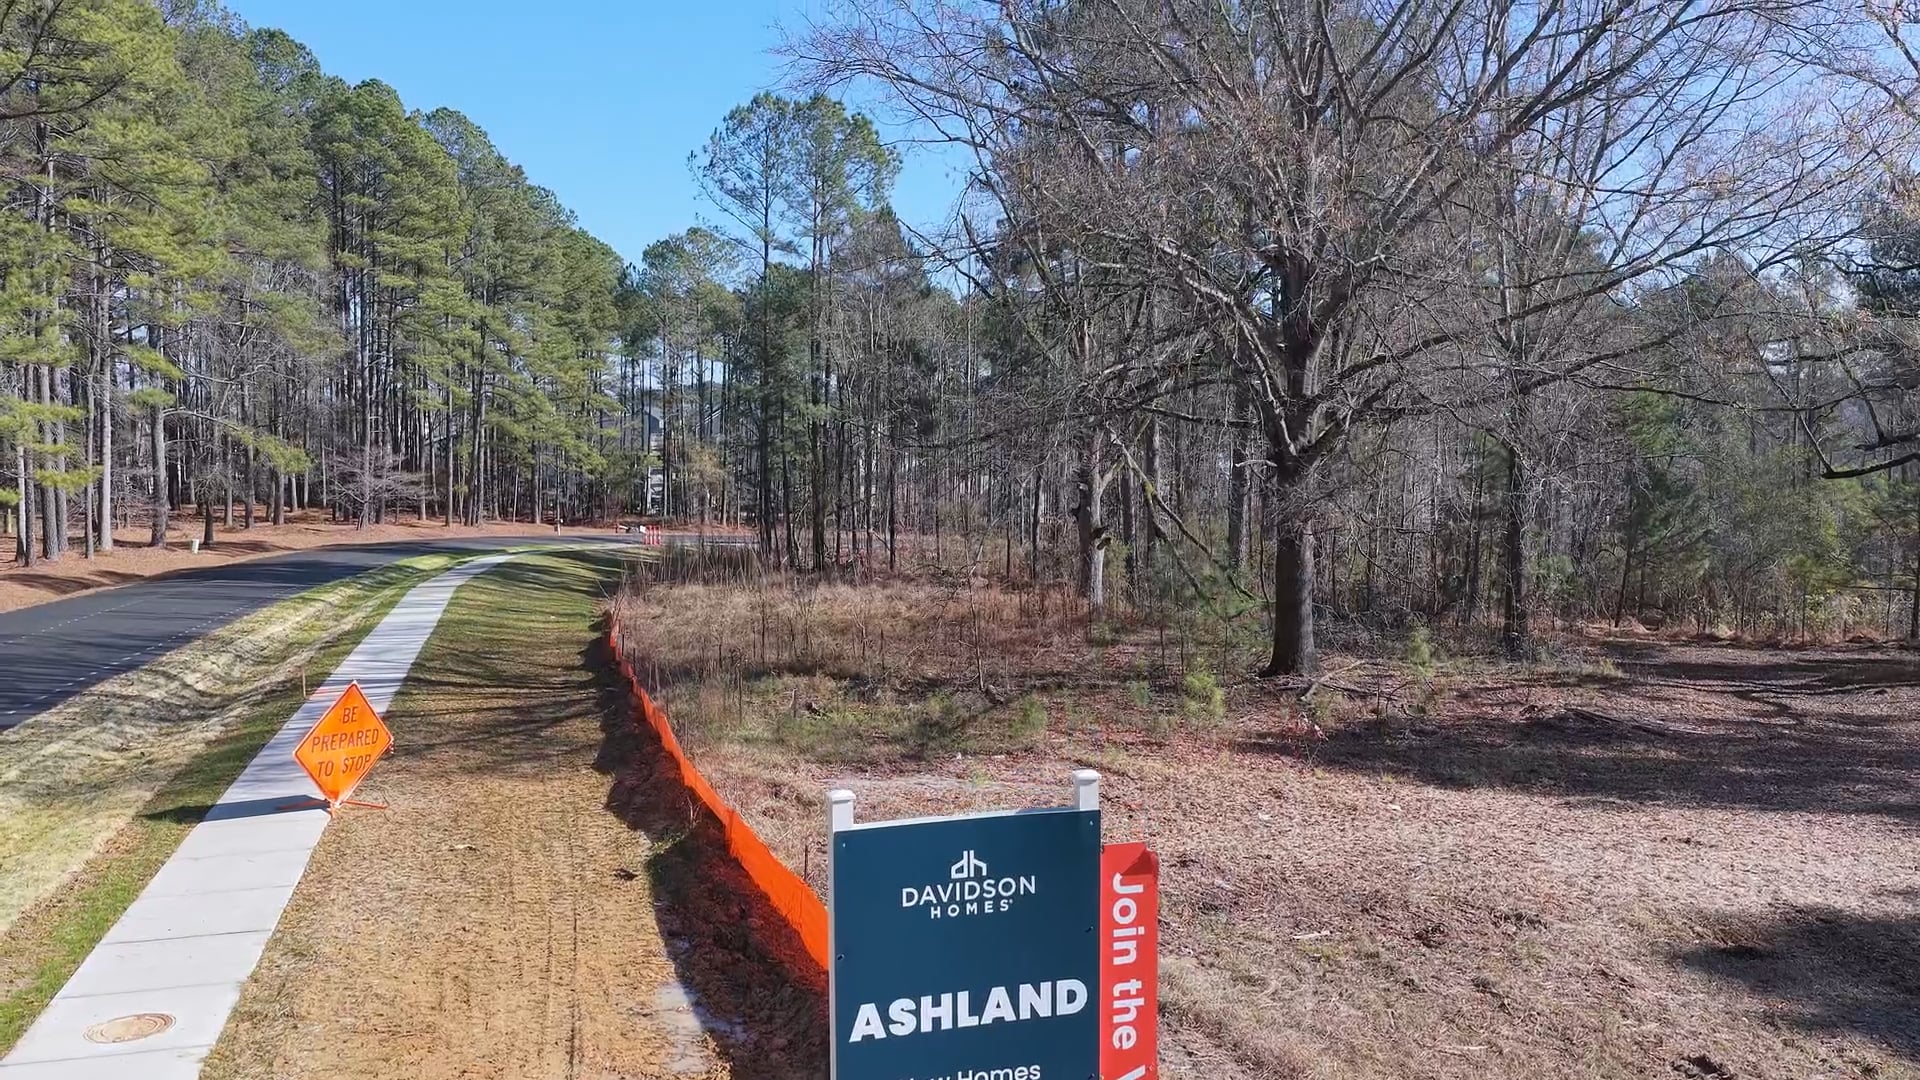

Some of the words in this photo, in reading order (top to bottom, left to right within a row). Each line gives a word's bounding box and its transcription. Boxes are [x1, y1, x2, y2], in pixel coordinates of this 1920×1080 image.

[342, 706, 359, 724] BE
[311, 728, 379, 753] PREPARED
[317, 760, 334, 778] TO
[342, 754, 372, 774] STOP
[902, 875, 1036, 907] DAVIDSON
[1112, 872, 1145, 966] Join
[849, 978, 1088, 1042] ASHLAND
[1112, 979, 1145, 1050] the
